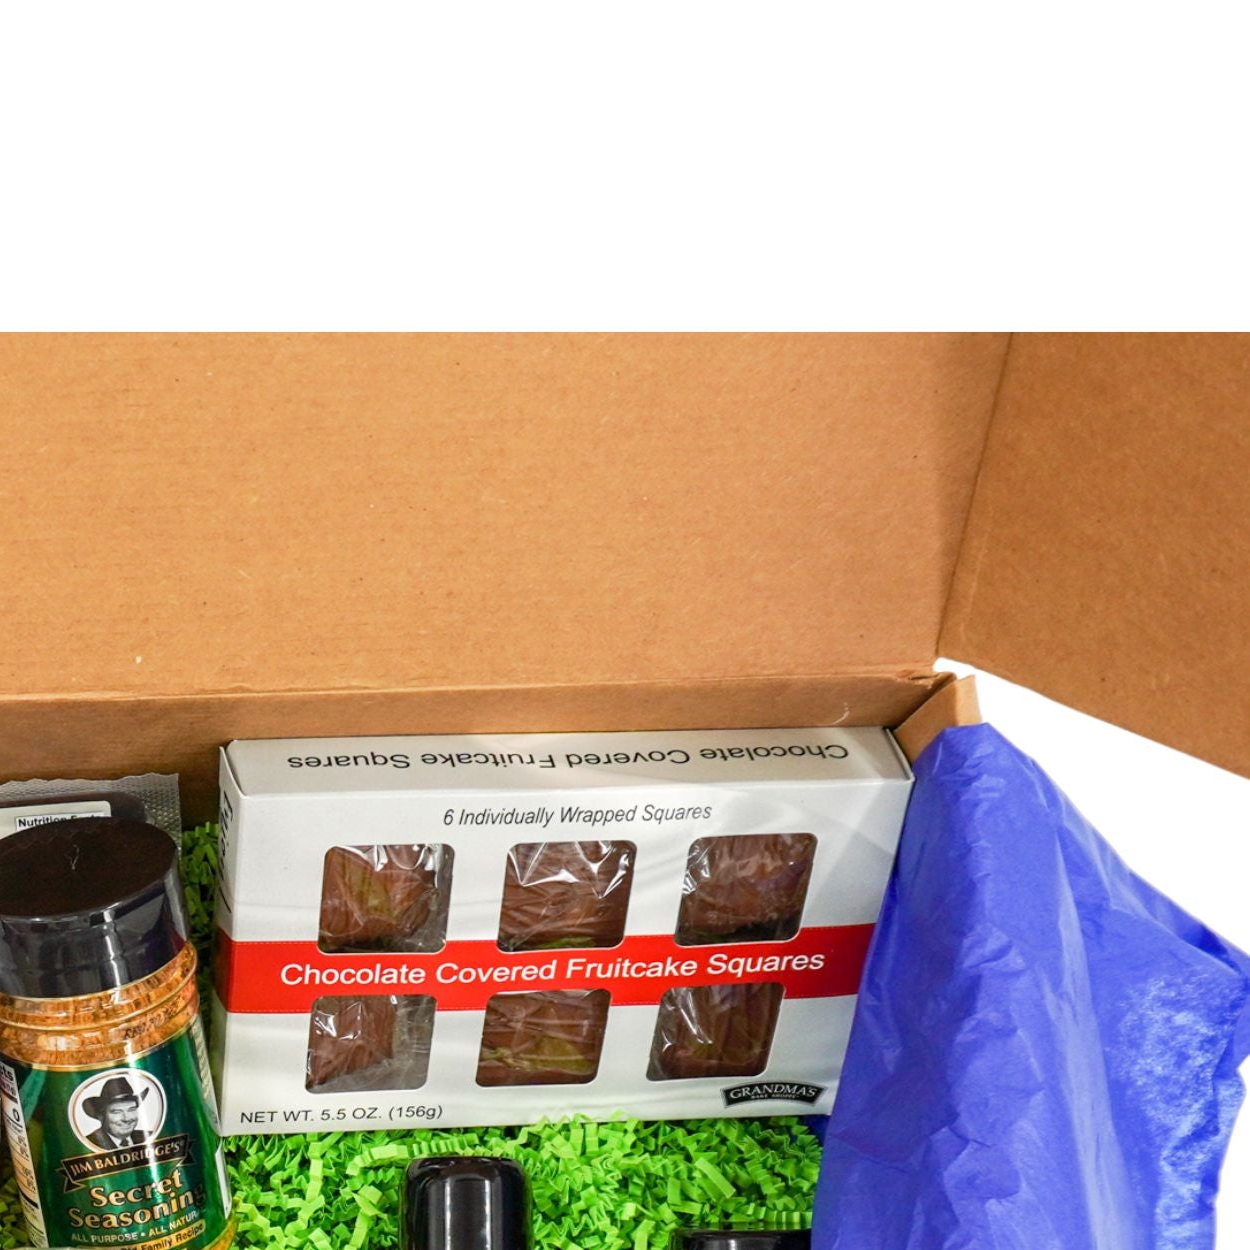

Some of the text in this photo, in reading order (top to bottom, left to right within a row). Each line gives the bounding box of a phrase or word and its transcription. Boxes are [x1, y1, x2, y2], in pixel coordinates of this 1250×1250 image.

[287, 743, 849, 772] Chocolate Covered Fruitcake Squares
[443, 803, 712, 827] 6 Individually Wrapped Squares
[280, 951, 825, 986] Chocolate Covered Fruitcake Squares
[730, 1084, 817, 1099] GRANDMA'S
[240, 1103, 444, 1124] NET WT. 5.5 OZ. (156g)
[70, 1158, 92, 1176] JIM
[90, 1168, 183, 1207] Secret
[68, 1183, 206, 1229] Seasoning
[71, 1232, 138, 1243] ALL PURPOSE
[149, 1226, 166, 1237] ALL
[176, 1223, 203, 1241] Recipe
